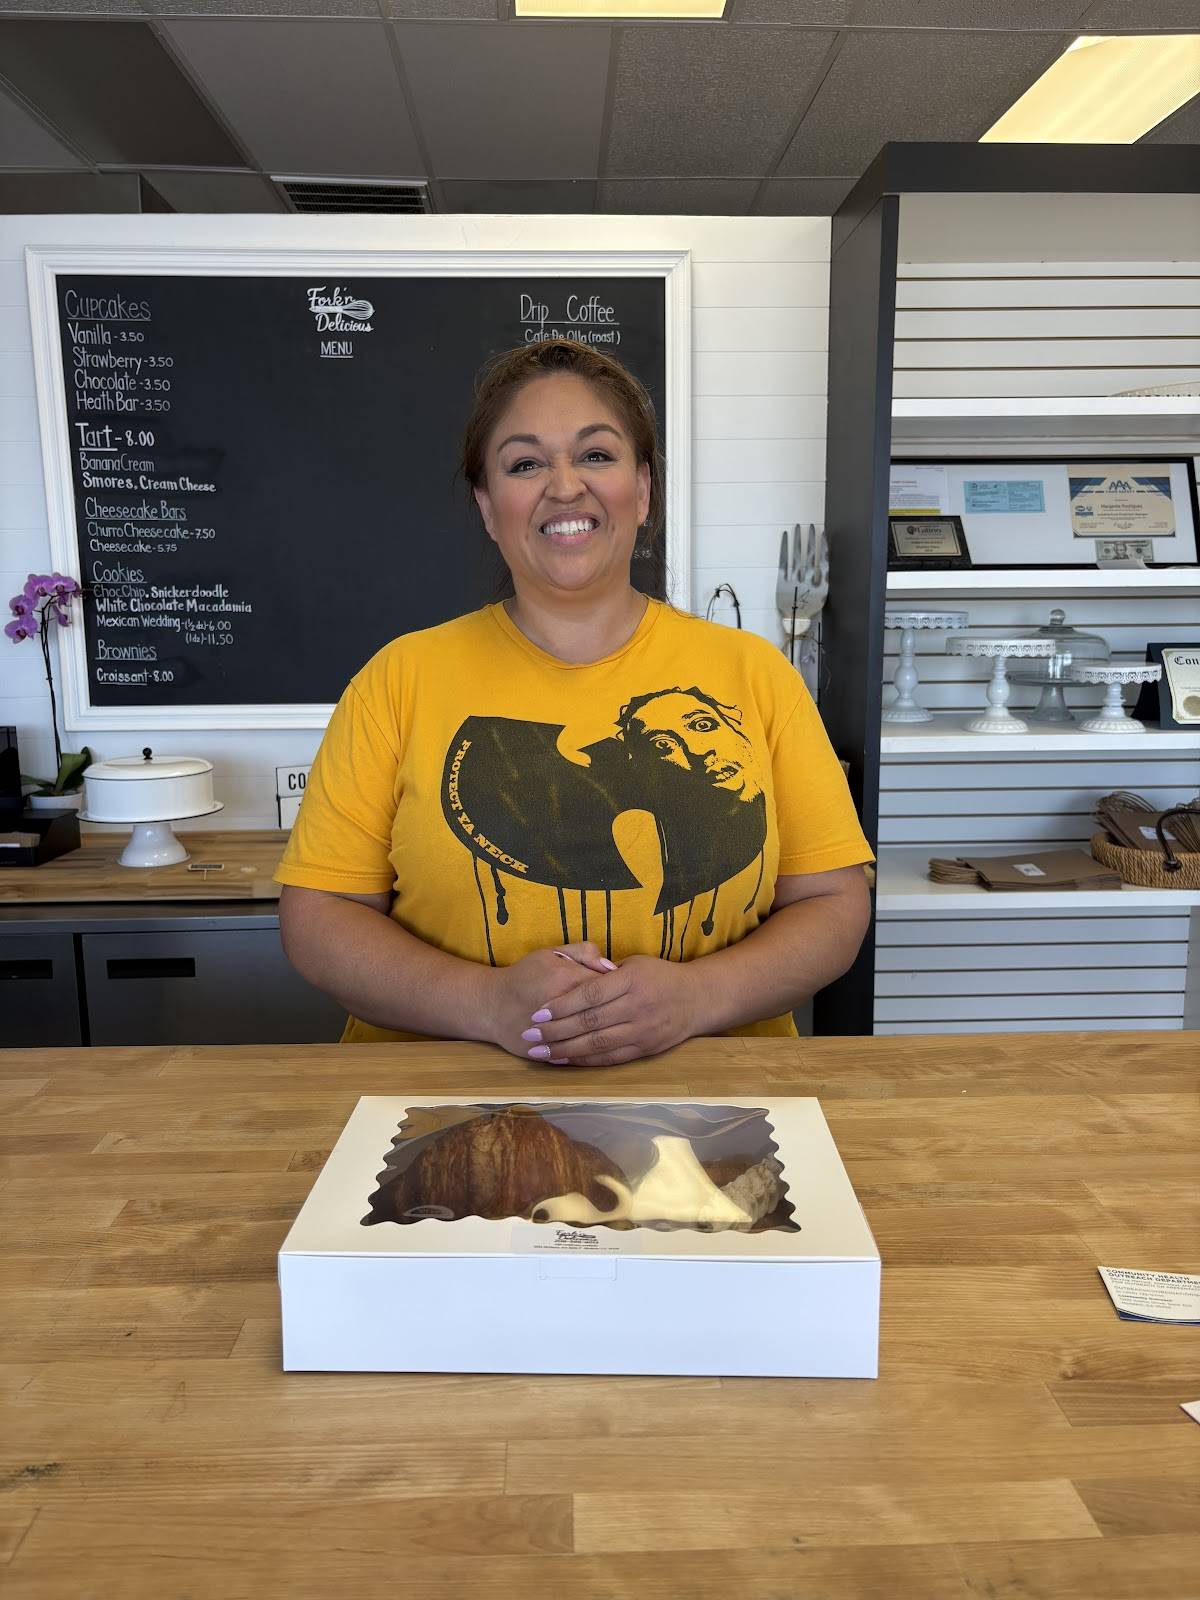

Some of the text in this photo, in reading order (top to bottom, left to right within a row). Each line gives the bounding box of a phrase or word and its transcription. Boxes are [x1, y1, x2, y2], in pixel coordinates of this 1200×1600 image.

[65, 290, 151, 320] Cupcakes
[520, 294, 615, 328] Drip Coffee
[315, 312, 374, 332] Delicious
[67, 322, 112, 344] Vanilla
[320, 341, 353, 355] MENU
[72, 346, 142, 375] Strawberry
[74, 369, 137, 390] Chocolate
[76, 391, 115, 411] Heath
[115, 391, 139, 411] Bar
[75, 422, 113, 447] Tart
[139, 475, 178, 491] Cream
[179, 476, 217, 492] Cheese
[85, 497, 187, 520] Cheesecake Bars
[87, 521, 124, 538] Churro
[89, 539, 152, 553] Cheesecake
[92, 560, 145, 583] Cookies
[150, 584, 230, 599] Snickerdoodle
[96, 599, 253, 613] White Chocolate Macadamia
[96, 615, 140, 627] Mexican
[97, 639, 157, 660] Brownies
[96, 667, 148, 683] Croissant
[448, 739, 472, 811] PROTECT
[473, 833, 529, 874] NECK
[1106, 1268, 1190, 1281] COMMUNITY HEALTH
[1108, 1272, 1153, 1281] OUTREACH
